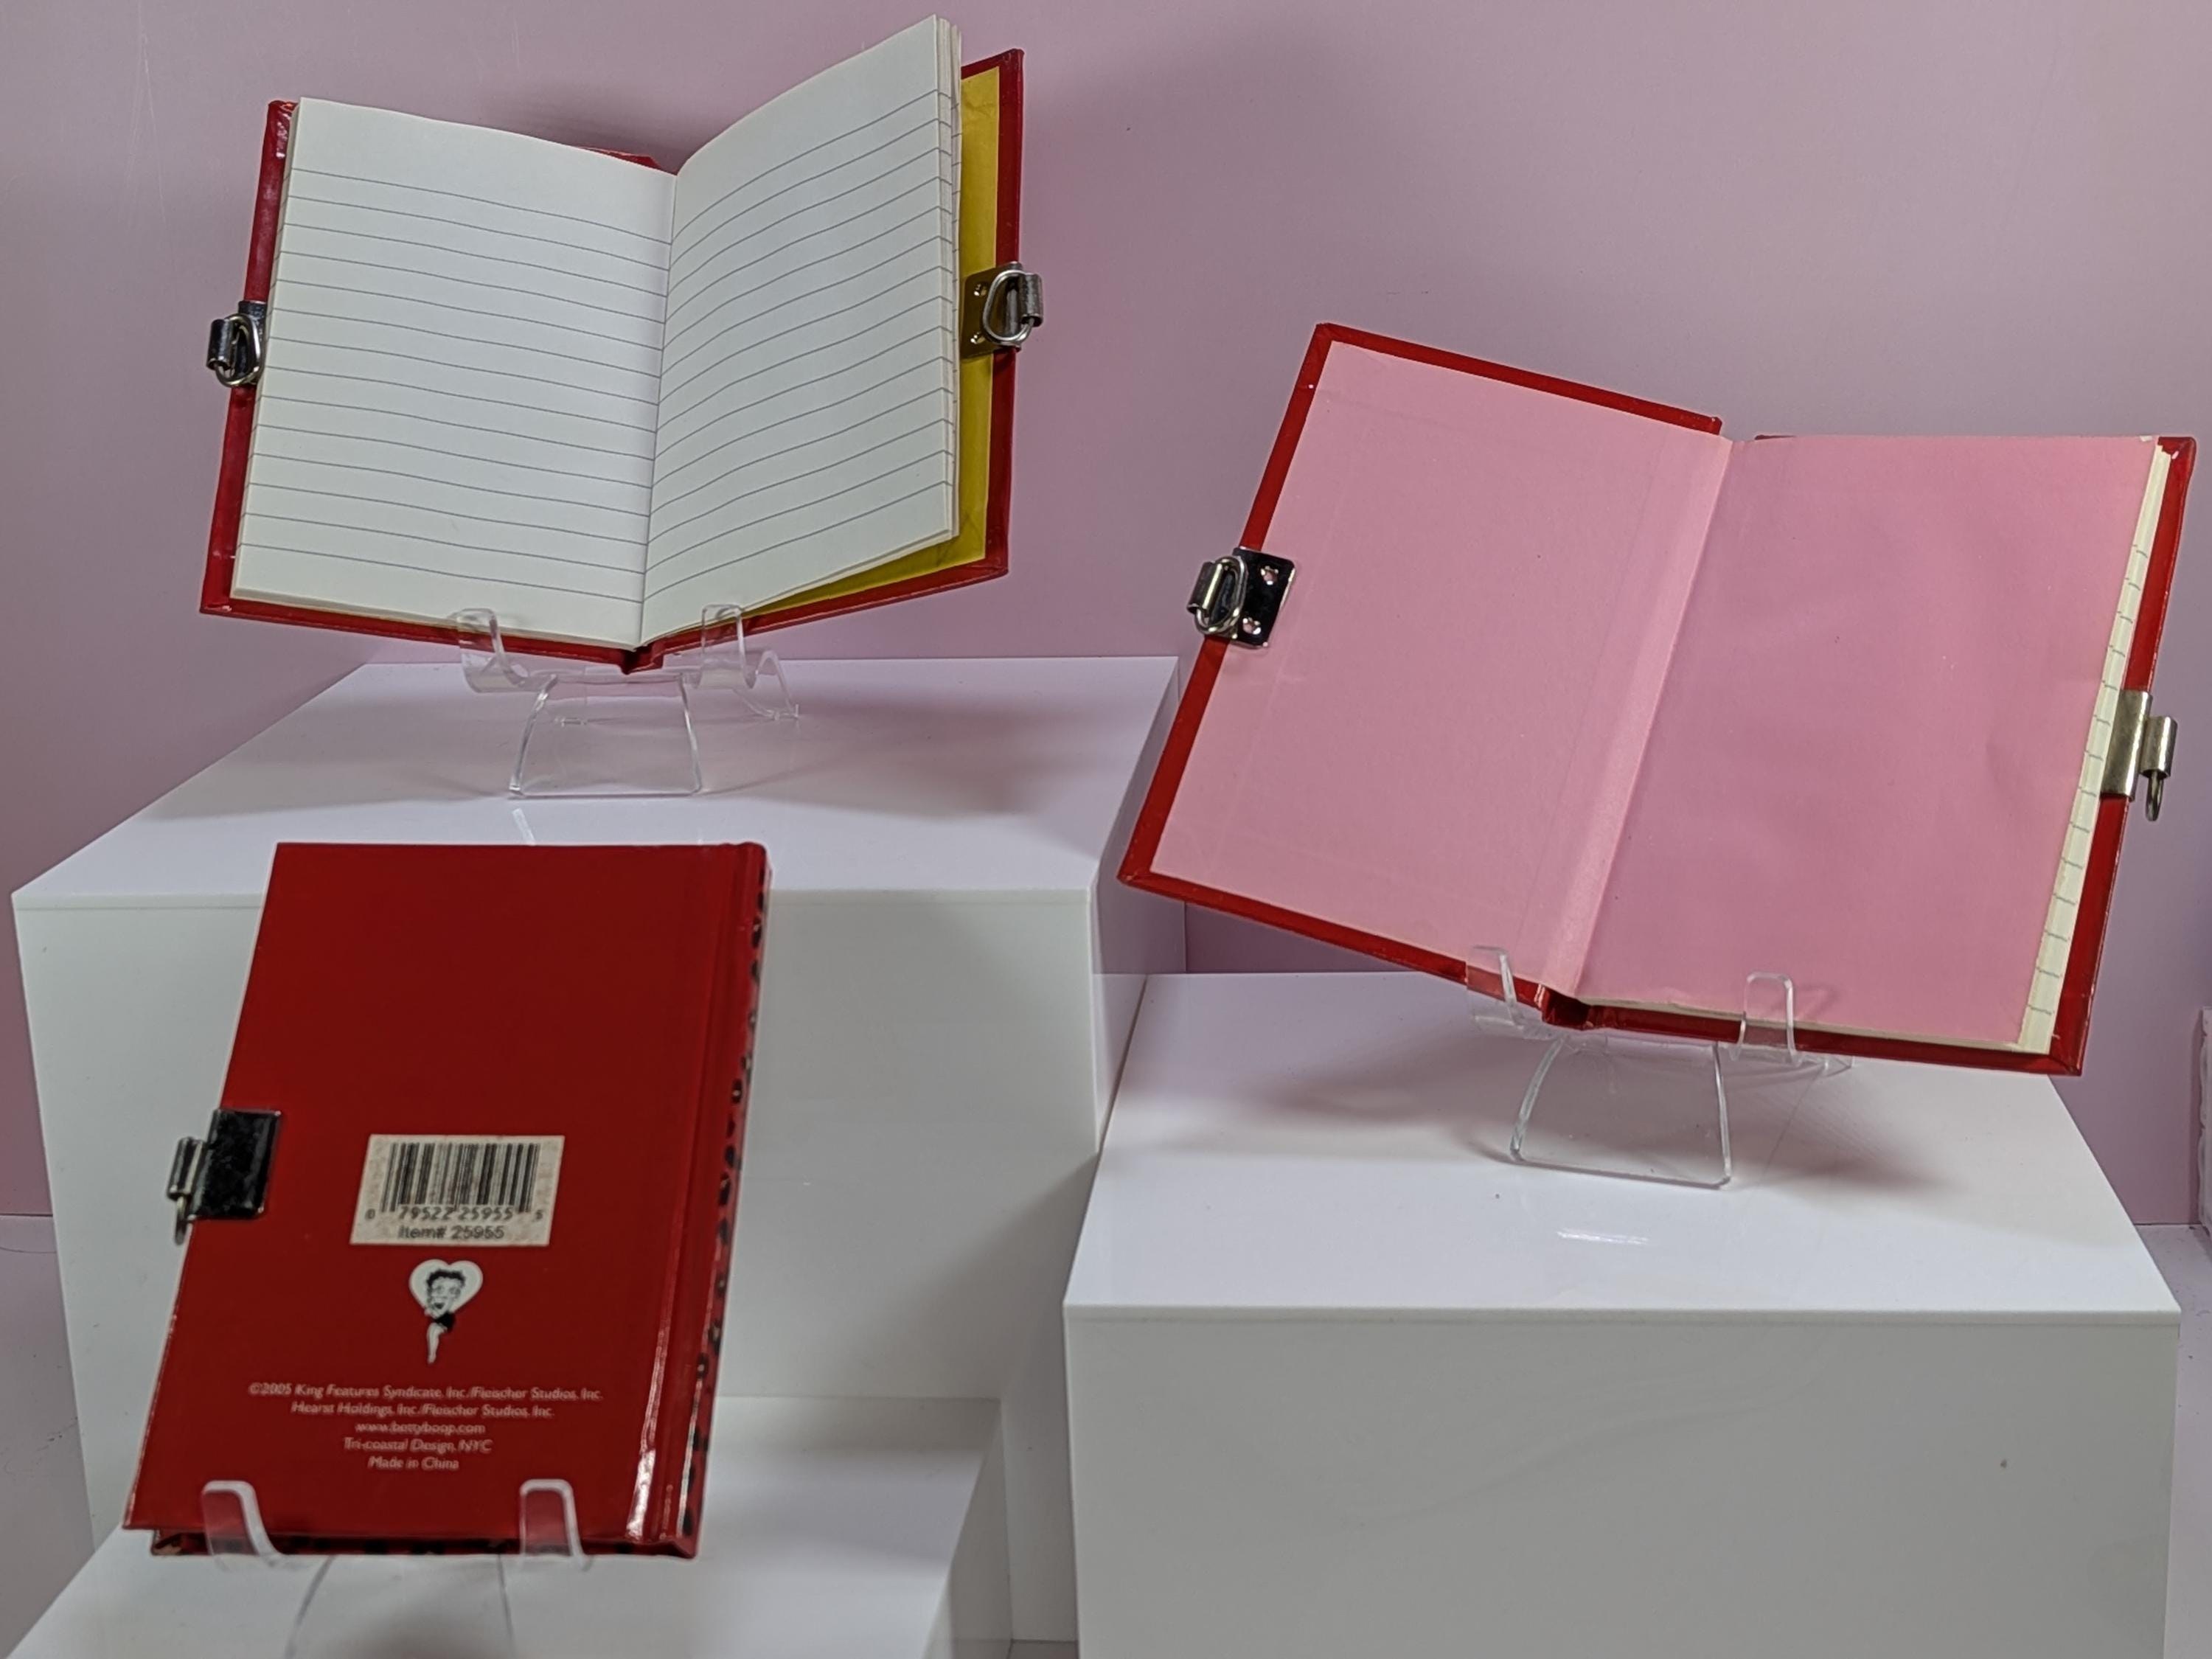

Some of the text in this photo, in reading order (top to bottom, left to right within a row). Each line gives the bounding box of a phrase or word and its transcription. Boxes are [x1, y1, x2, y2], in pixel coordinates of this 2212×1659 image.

[459, 1206, 514, 1221] 25955
[397, 1225, 505, 1239] Item# 25955
[294, 1384, 324, 1399] King
[326, 1384, 379, 1397] Features
[581, 1388, 603, 1400] Inc.
[291, 1401, 335, 1413] Hearst
[532, 1405, 554, 1417] Inc.
[355, 1421, 486, 1436] www.bettyboop.com
[344, 1437, 408, 1450] Tri-coastal
[458, 1439, 493, 1453] NYC
[367, 1455, 459, 1470] Made in China
